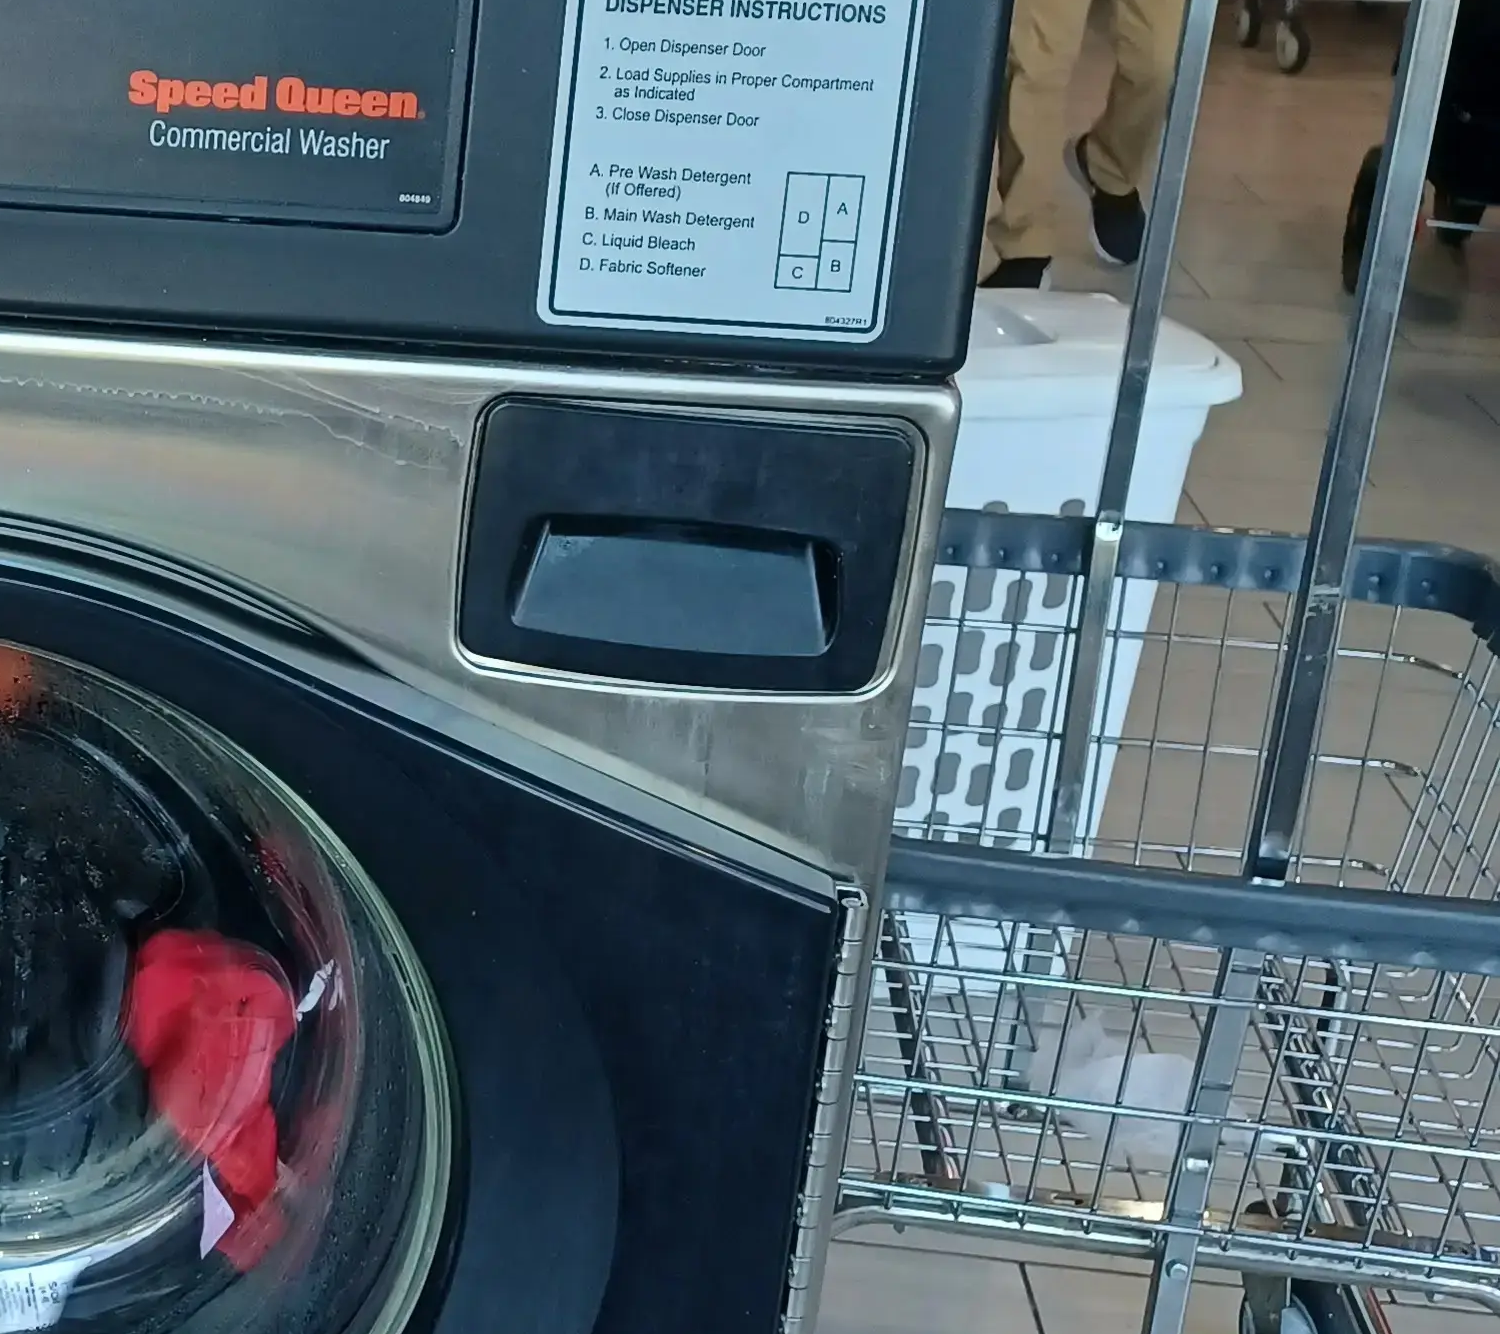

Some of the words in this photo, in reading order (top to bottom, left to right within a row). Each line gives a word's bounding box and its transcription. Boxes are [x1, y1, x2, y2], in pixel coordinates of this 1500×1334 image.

[604, 37, 614, 50] 1.
[619, 38, 656, 54] Open
[660, 39, 729, 56] Dispenser
[732, 42, 766, 56] Door
[599, 66, 612, 79] 2.
[616, 68, 649, 81] Load
[654, 69, 711, 85] Supplies
[716, 71, 727, 84] in
[731, 73, 777, 87] Proper
[781, 75, 874, 92] Compartment
[128, 69, 268, 113] Speed
[276, 76, 419, 119] Queen
[614, 87, 629, 98] as
[634, 86, 694, 101] Indicated
[596, 106, 608, 119] 3.
[612, 107, 650, 122] Close
[654, 109, 722, 126] Dispenser
[726, 113, 759, 126] Door
[149, 119, 291, 155] Commercial
[300, 129, 390, 159] Washer
[589, 164, 604, 177] A.
[609, 165, 634, 178] Pre
[638, 166, 677, 181] Wash
[681, 168, 751, 186] Detergent
[605, 183, 621, 198] (If
[624, 184, 681, 200] Offered)
[798, 211, 809, 224] D
[836, 202, 848, 215] A
[585, 207, 599, 219] B.
[604, 208, 637, 222] Main
[642, 211, 681, 225] Wash
[686, 213, 754, 230] Detergent
[582, 233, 597, 246] C.
[602, 234, 643, 250] Liquid
[648, 236, 695, 250] Bleach
[579, 258, 594, 271] D.
[599, 259, 642, 274] Fabric
[646, 261, 706, 277] Softener
[792, 266, 803, 279] C
[831, 260, 841, 272] B
